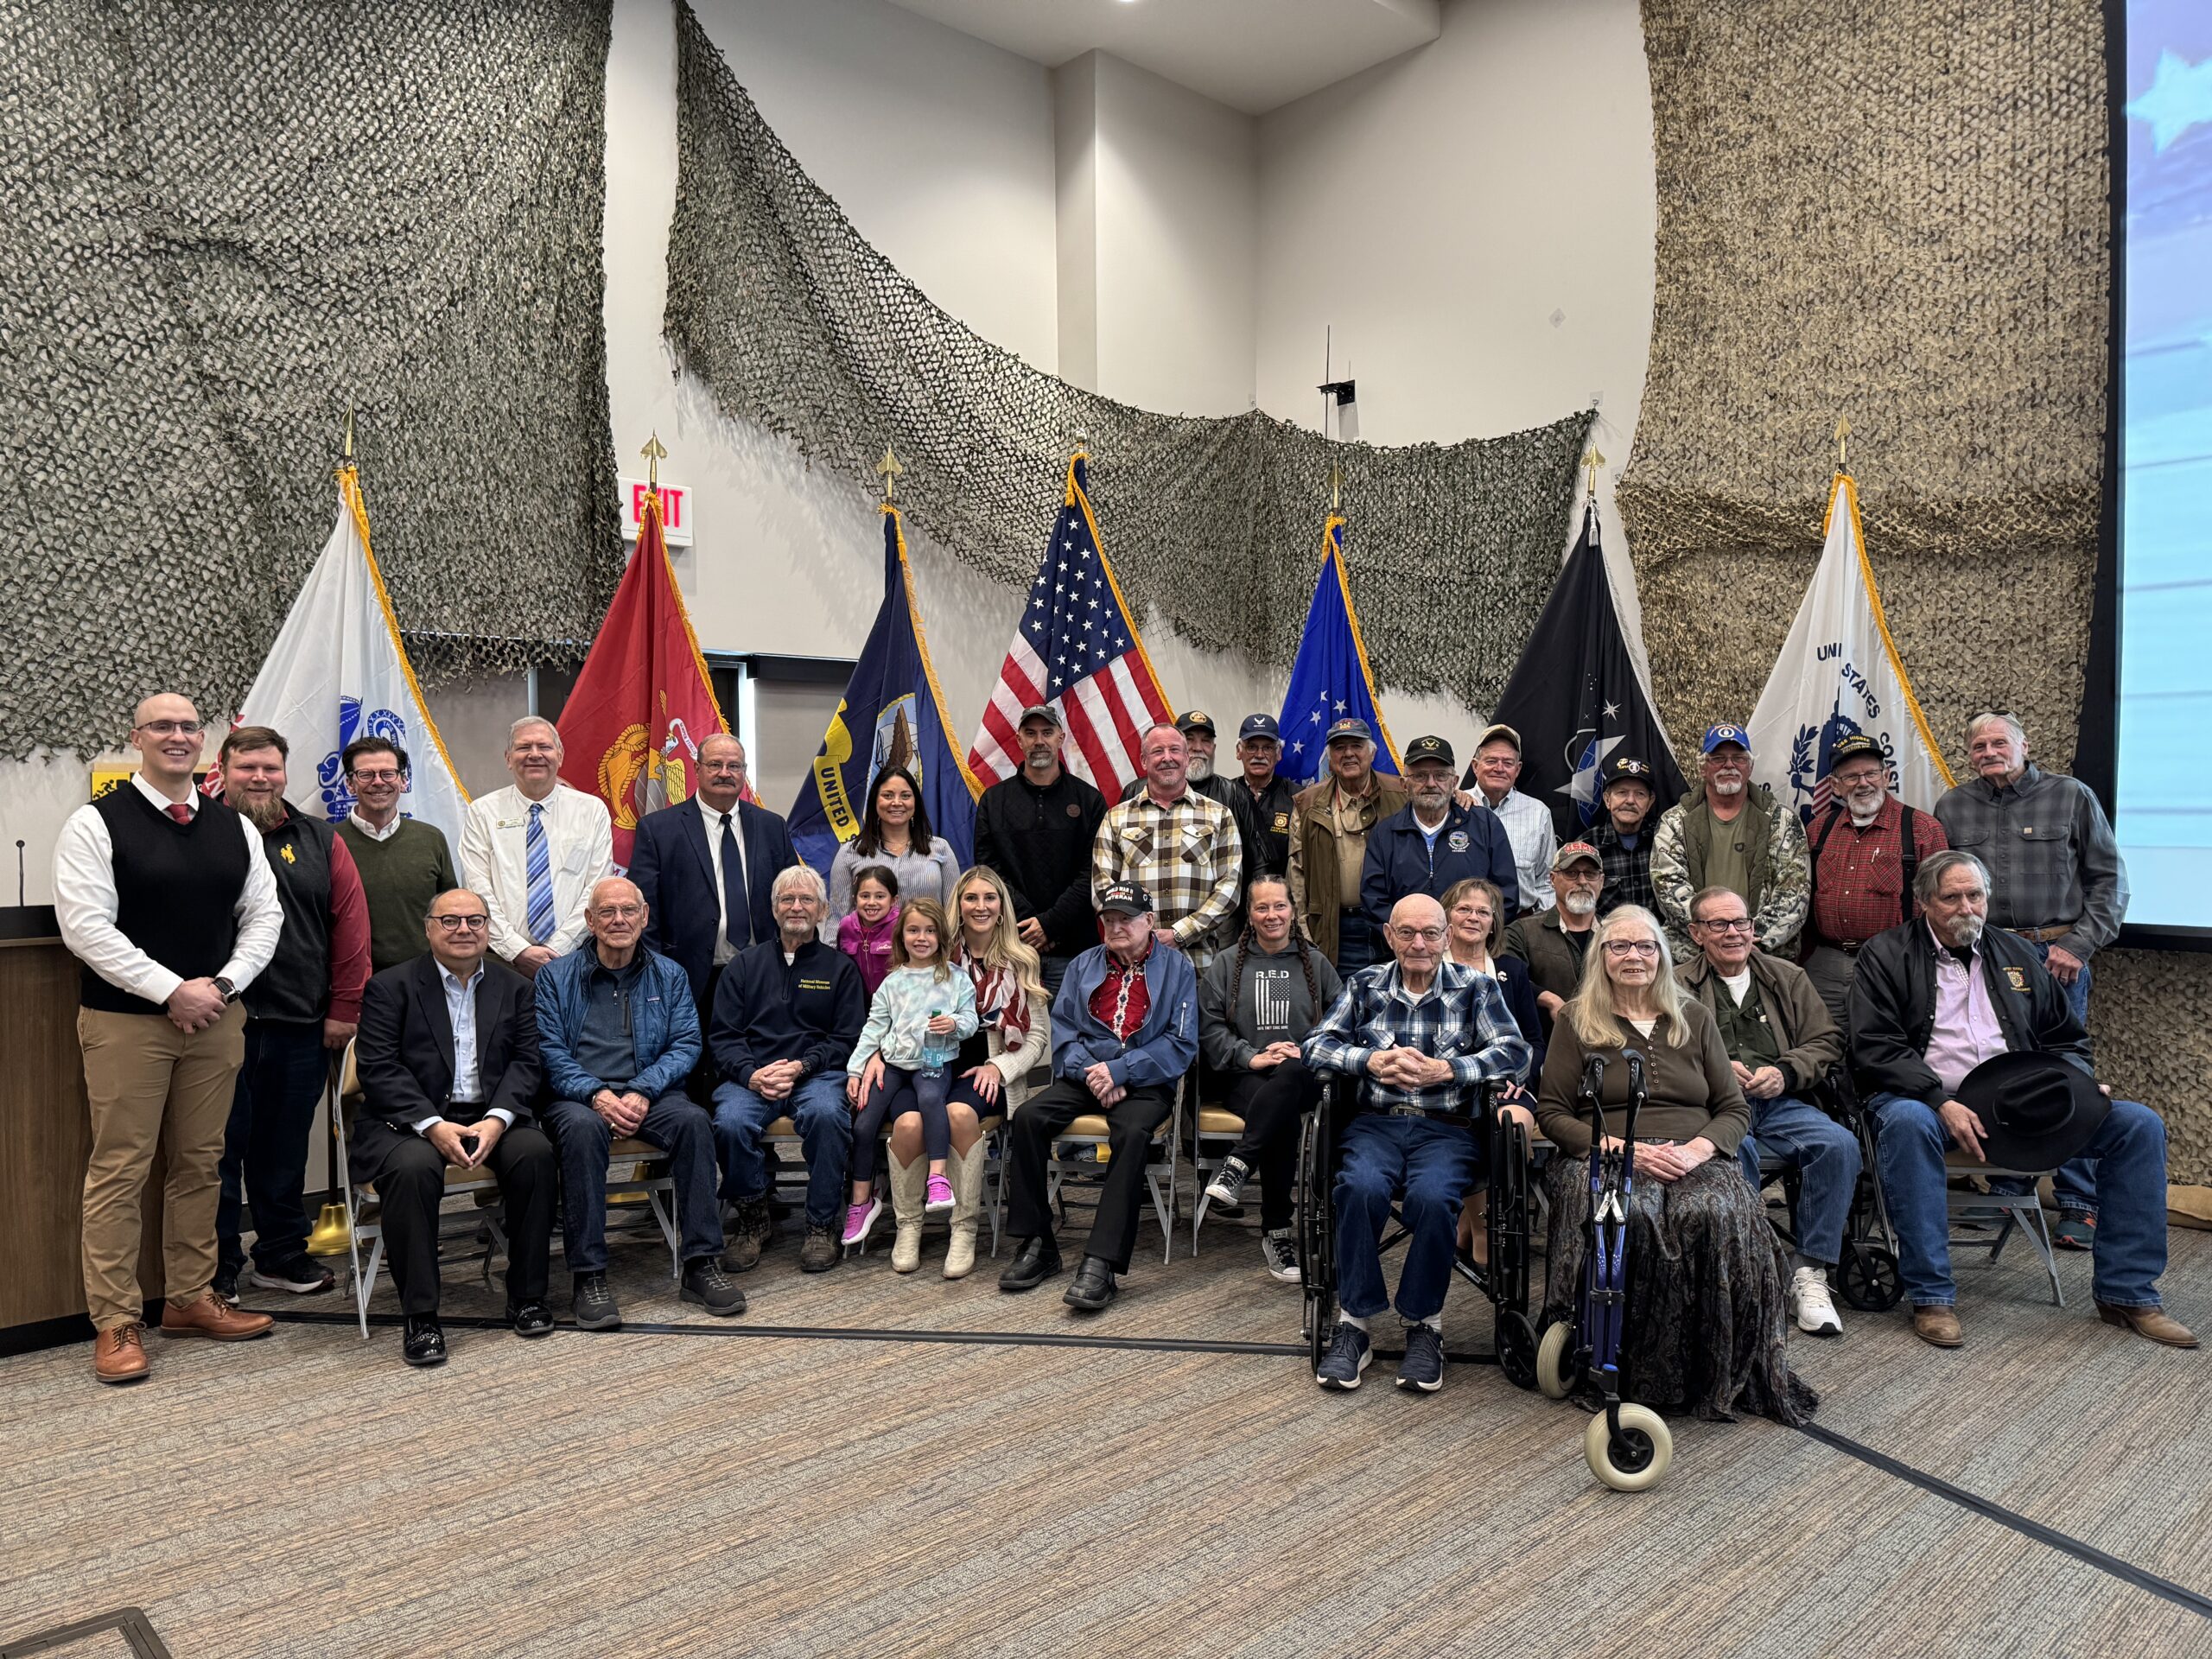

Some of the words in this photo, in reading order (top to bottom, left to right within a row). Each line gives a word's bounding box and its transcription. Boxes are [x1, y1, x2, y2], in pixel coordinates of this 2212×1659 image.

[632, 484, 683, 527] EIT
[1841, 663, 1880, 719] STATES
[1879, 732, 1900, 794] COAST
[821, 766, 849, 828] UNITED
[1255, 969, 1290, 979] R.E.D
